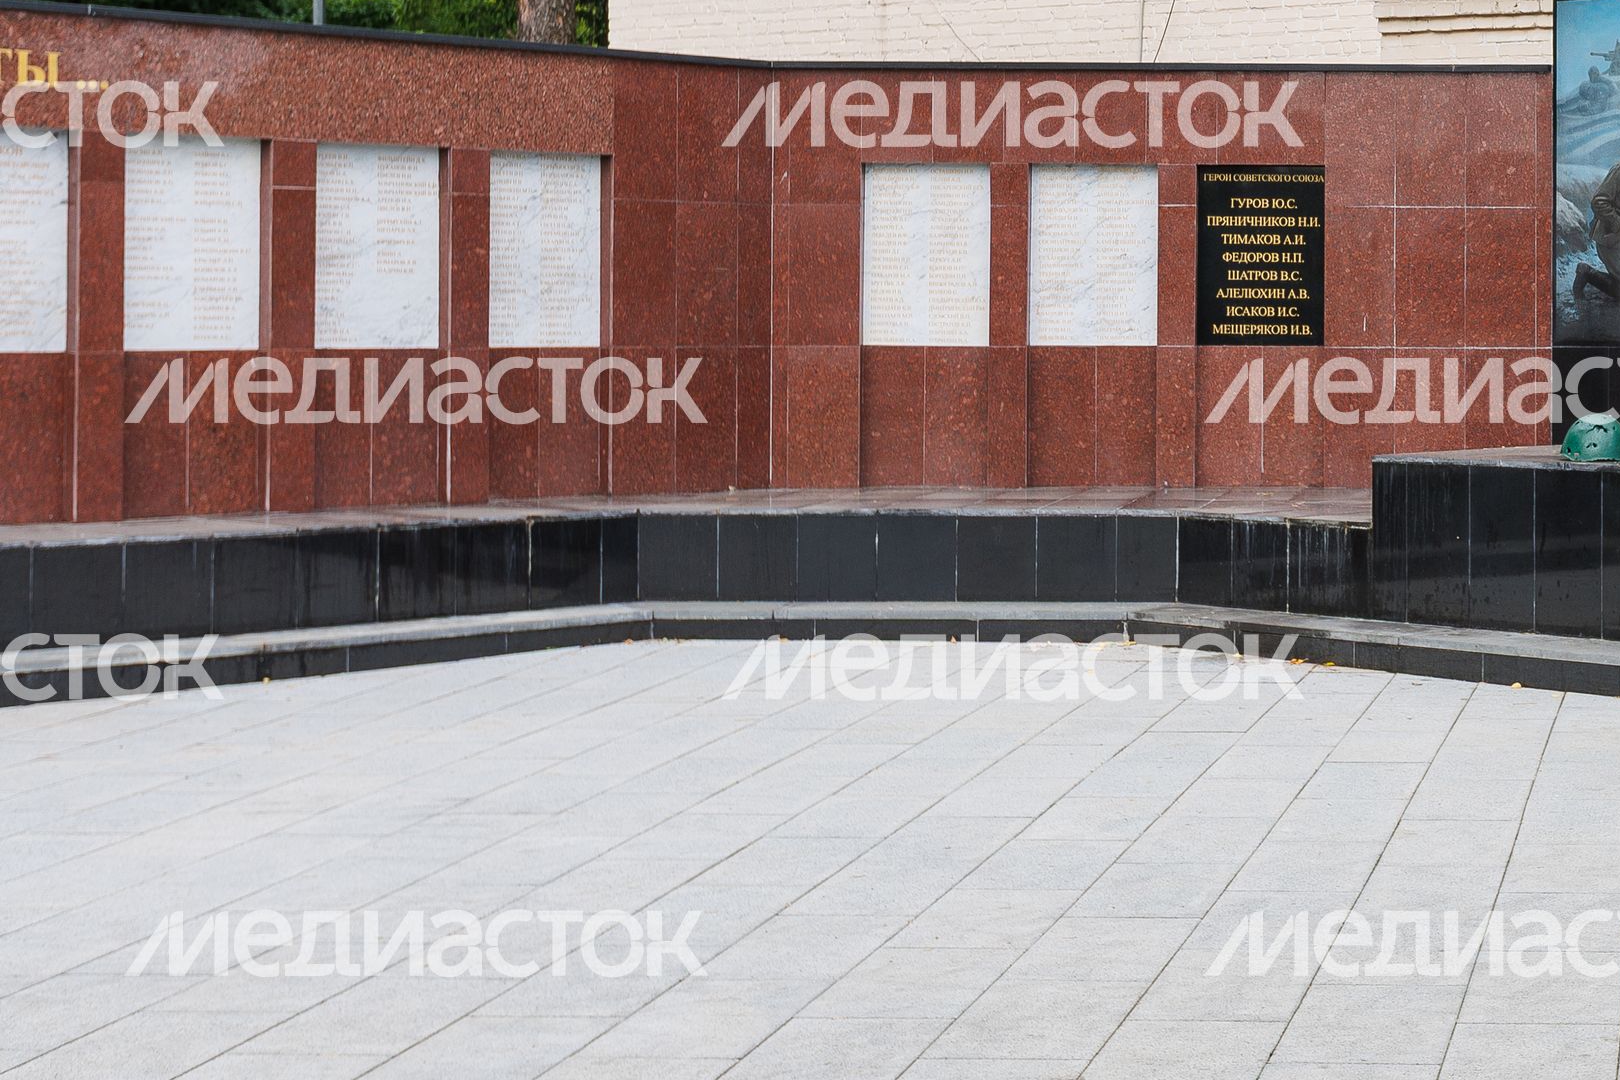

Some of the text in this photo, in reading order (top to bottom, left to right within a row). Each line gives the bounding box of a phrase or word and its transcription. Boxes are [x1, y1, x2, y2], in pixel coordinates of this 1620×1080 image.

[1203, 173, 1324, 183] ГЕРОИ СОВЕТСКОГО СОЮЗА
[1230, 198, 1298, 209] ГУРОВ Ю.С.
[1207, 216, 1321, 227] ПРЯНИЧНИКОВ Н.И.
[1221, 234, 1306, 245] ТИМАКОВ А.И.
[1222, 252, 1305, 264] ФЕДОРОВ Н.П.
[1227, 270, 1302, 281] ШАТРОВ В.С.
[1216, 288, 1310, 299] АЛЕЛЮХИН А.В.
[1226, 306, 1300, 317] ИСАКОВ И.С.
[1212, 324, 1313, 336] МЕЩЕРЯКОВ И.В.
